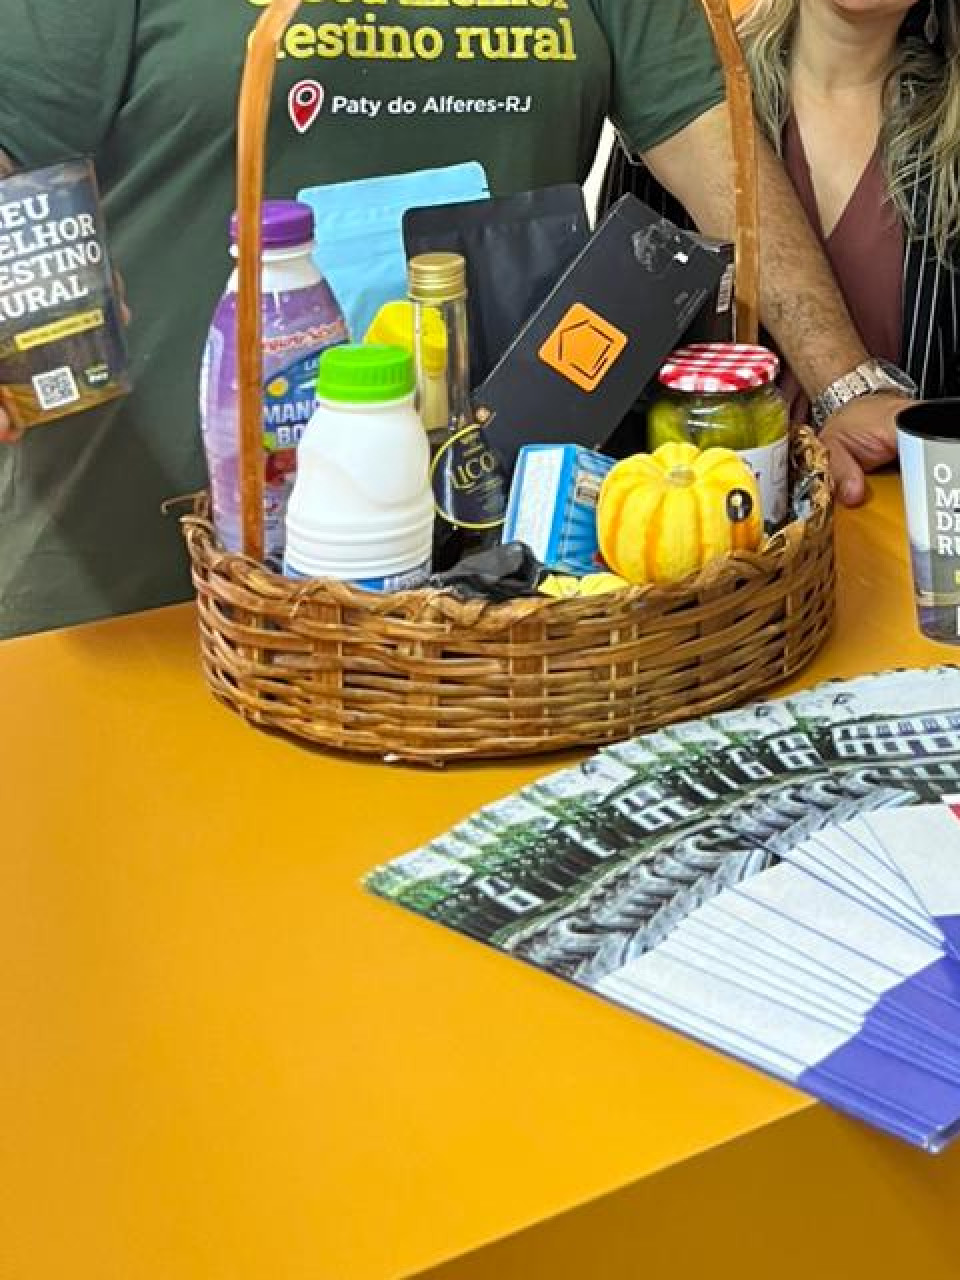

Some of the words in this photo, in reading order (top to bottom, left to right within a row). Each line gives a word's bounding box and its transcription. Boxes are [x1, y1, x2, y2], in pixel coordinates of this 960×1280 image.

[247, 13, 444, 59] estino
[456, 18, 576, 60] rural
[332, 95, 382, 118] Paty
[388, 95, 417, 114] do
[423, 95, 532, 114] Alferes-RJ
[0, 193, 50, 228] EU
[0, 274, 88, 320] URAL
[934, 463, 952, 484] O
